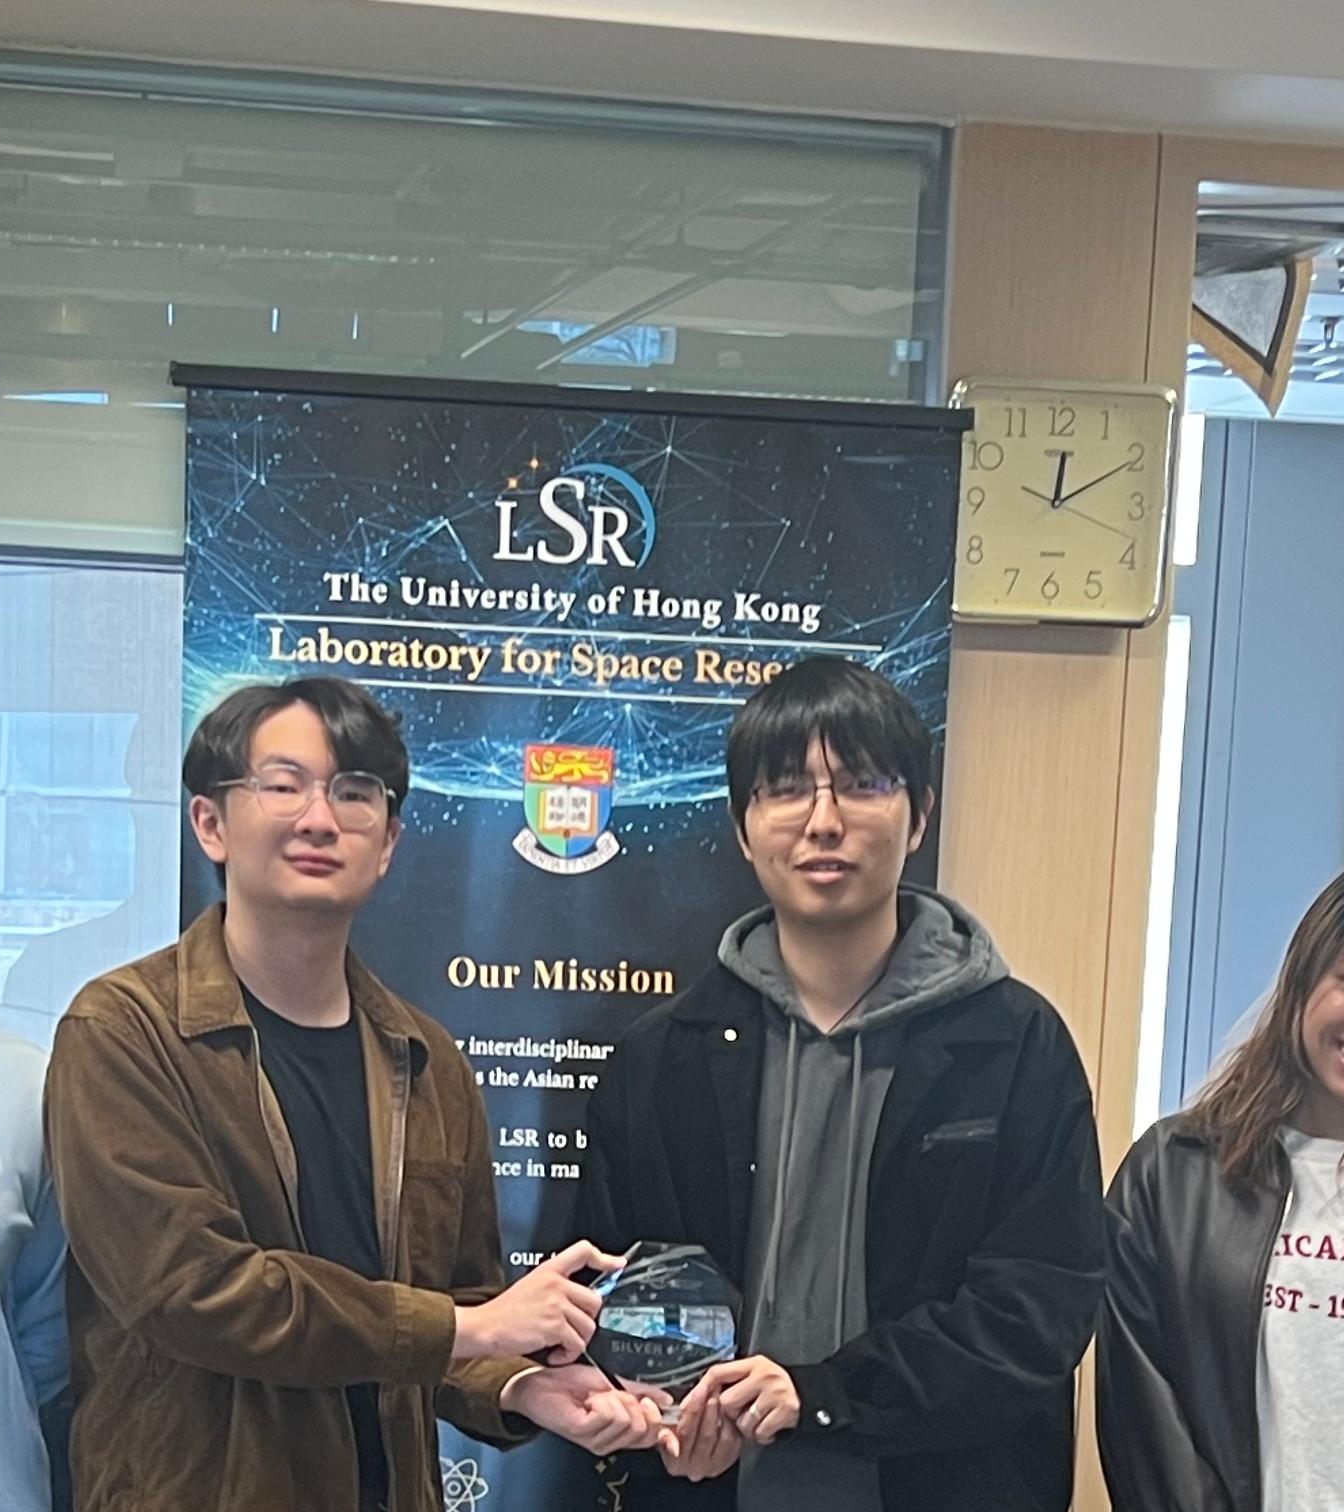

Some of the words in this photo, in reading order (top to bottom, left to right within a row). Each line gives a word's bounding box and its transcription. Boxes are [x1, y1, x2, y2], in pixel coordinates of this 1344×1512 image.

[1004, 406, 1027, 439] 11
[1047, 405, 1076, 438] 12
[1100, 410, 1109, 441] 1
[968, 440, 1004, 472] 10
[1126, 442, 1145, 473] 2
[966, 487, 985, 516] 9
[1127, 491, 1145, 523] 3
[492, 476, 636, 568] LSR
[966, 534, 984, 566] 8
[1118, 540, 1136, 571] 4
[1003, 568, 1021, 597] 7
[1040, 571, 1060, 600] 6
[1084, 570, 1103, 600] 5
[323, 571, 388, 604] The
[400, 576, 576, 622] University
[587, 584, 626, 615] of
[632, 588, 723, 629] Hong
[733, 591, 822, 634] Kong
[268, 625, 492, 682] Laboratory
[501, 636, 561, 676] for
[570, 642, 683, 686] Space
[693, 648, 794, 686] Rese
[447, 955, 521, 990] Our
[531, 960, 676, 995] Mission
[489, 1066, 520, 1087] the
[523, 1068, 575, 1089] Asian
[499, 1127, 539, 1148] LSR
[547, 1132, 567, 1149] to
[526, 1158, 546, 1178] in
[509, 1250, 544, 1267] our
[610, 1339, 662, 1356] SILVER
